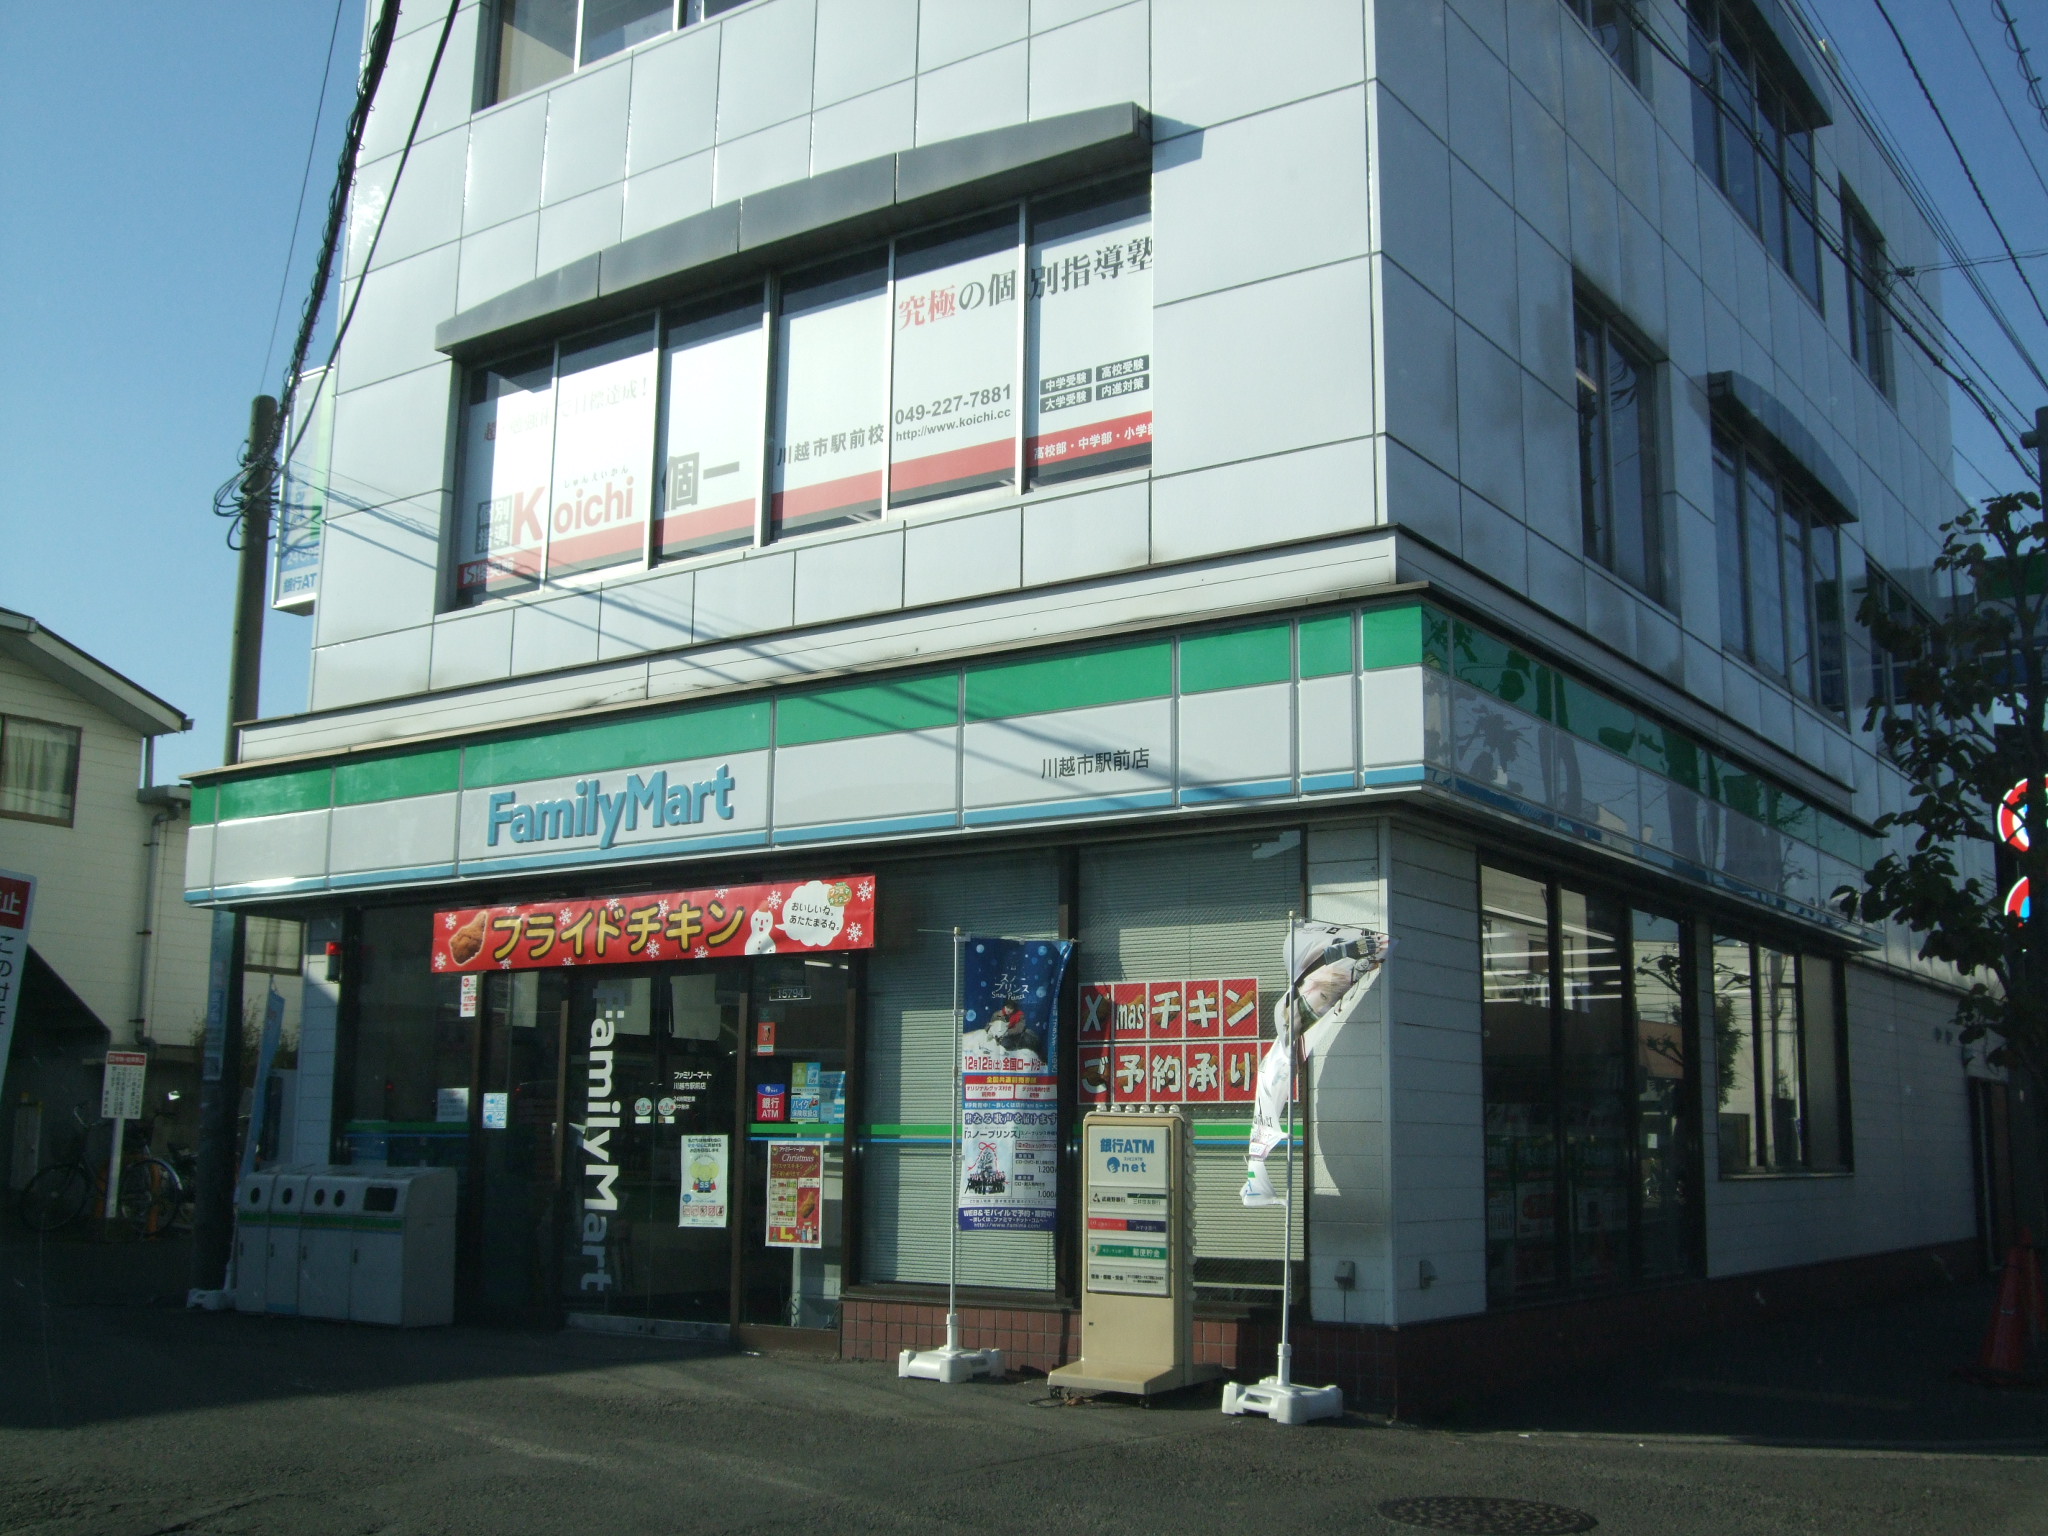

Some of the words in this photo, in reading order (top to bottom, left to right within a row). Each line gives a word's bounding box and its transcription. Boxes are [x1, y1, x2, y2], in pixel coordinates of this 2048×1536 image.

[1101, 358, 1144, 379] 高校受験
[1044, 371, 1087, 392] 中学受験
[1101, 377, 1144, 398] 内進対策
[894, 383, 1013, 426] 049-227-7881
[1044, 390, 1087, 411] 大学受験
[895, 408, 1012, 442] http://www.koichi.cc
[776, 424, 885, 467] 川越市駅前校
[511, 475, 634, 547] Koichi
[1041, 747, 1151, 781] 川越市駅前店
[486, 762, 736, 849] FamilyMart
[791, 901, 835, 918] おいしいね。
[492, 899, 746, 962] フライドチキン
[789, 914, 841, 932] あたたまるね。
[674, 1071, 712, 1080] ファミリーマート
[1081, 1051, 1250, 1094] ご予約承り
[761, 1097, 780, 1109] 銀行
[761, 1109, 779, 1119] ATM
[1100, 1138, 1155, 1154] 銀行ATM
[781, 1153, 815, 1163] Christmas
